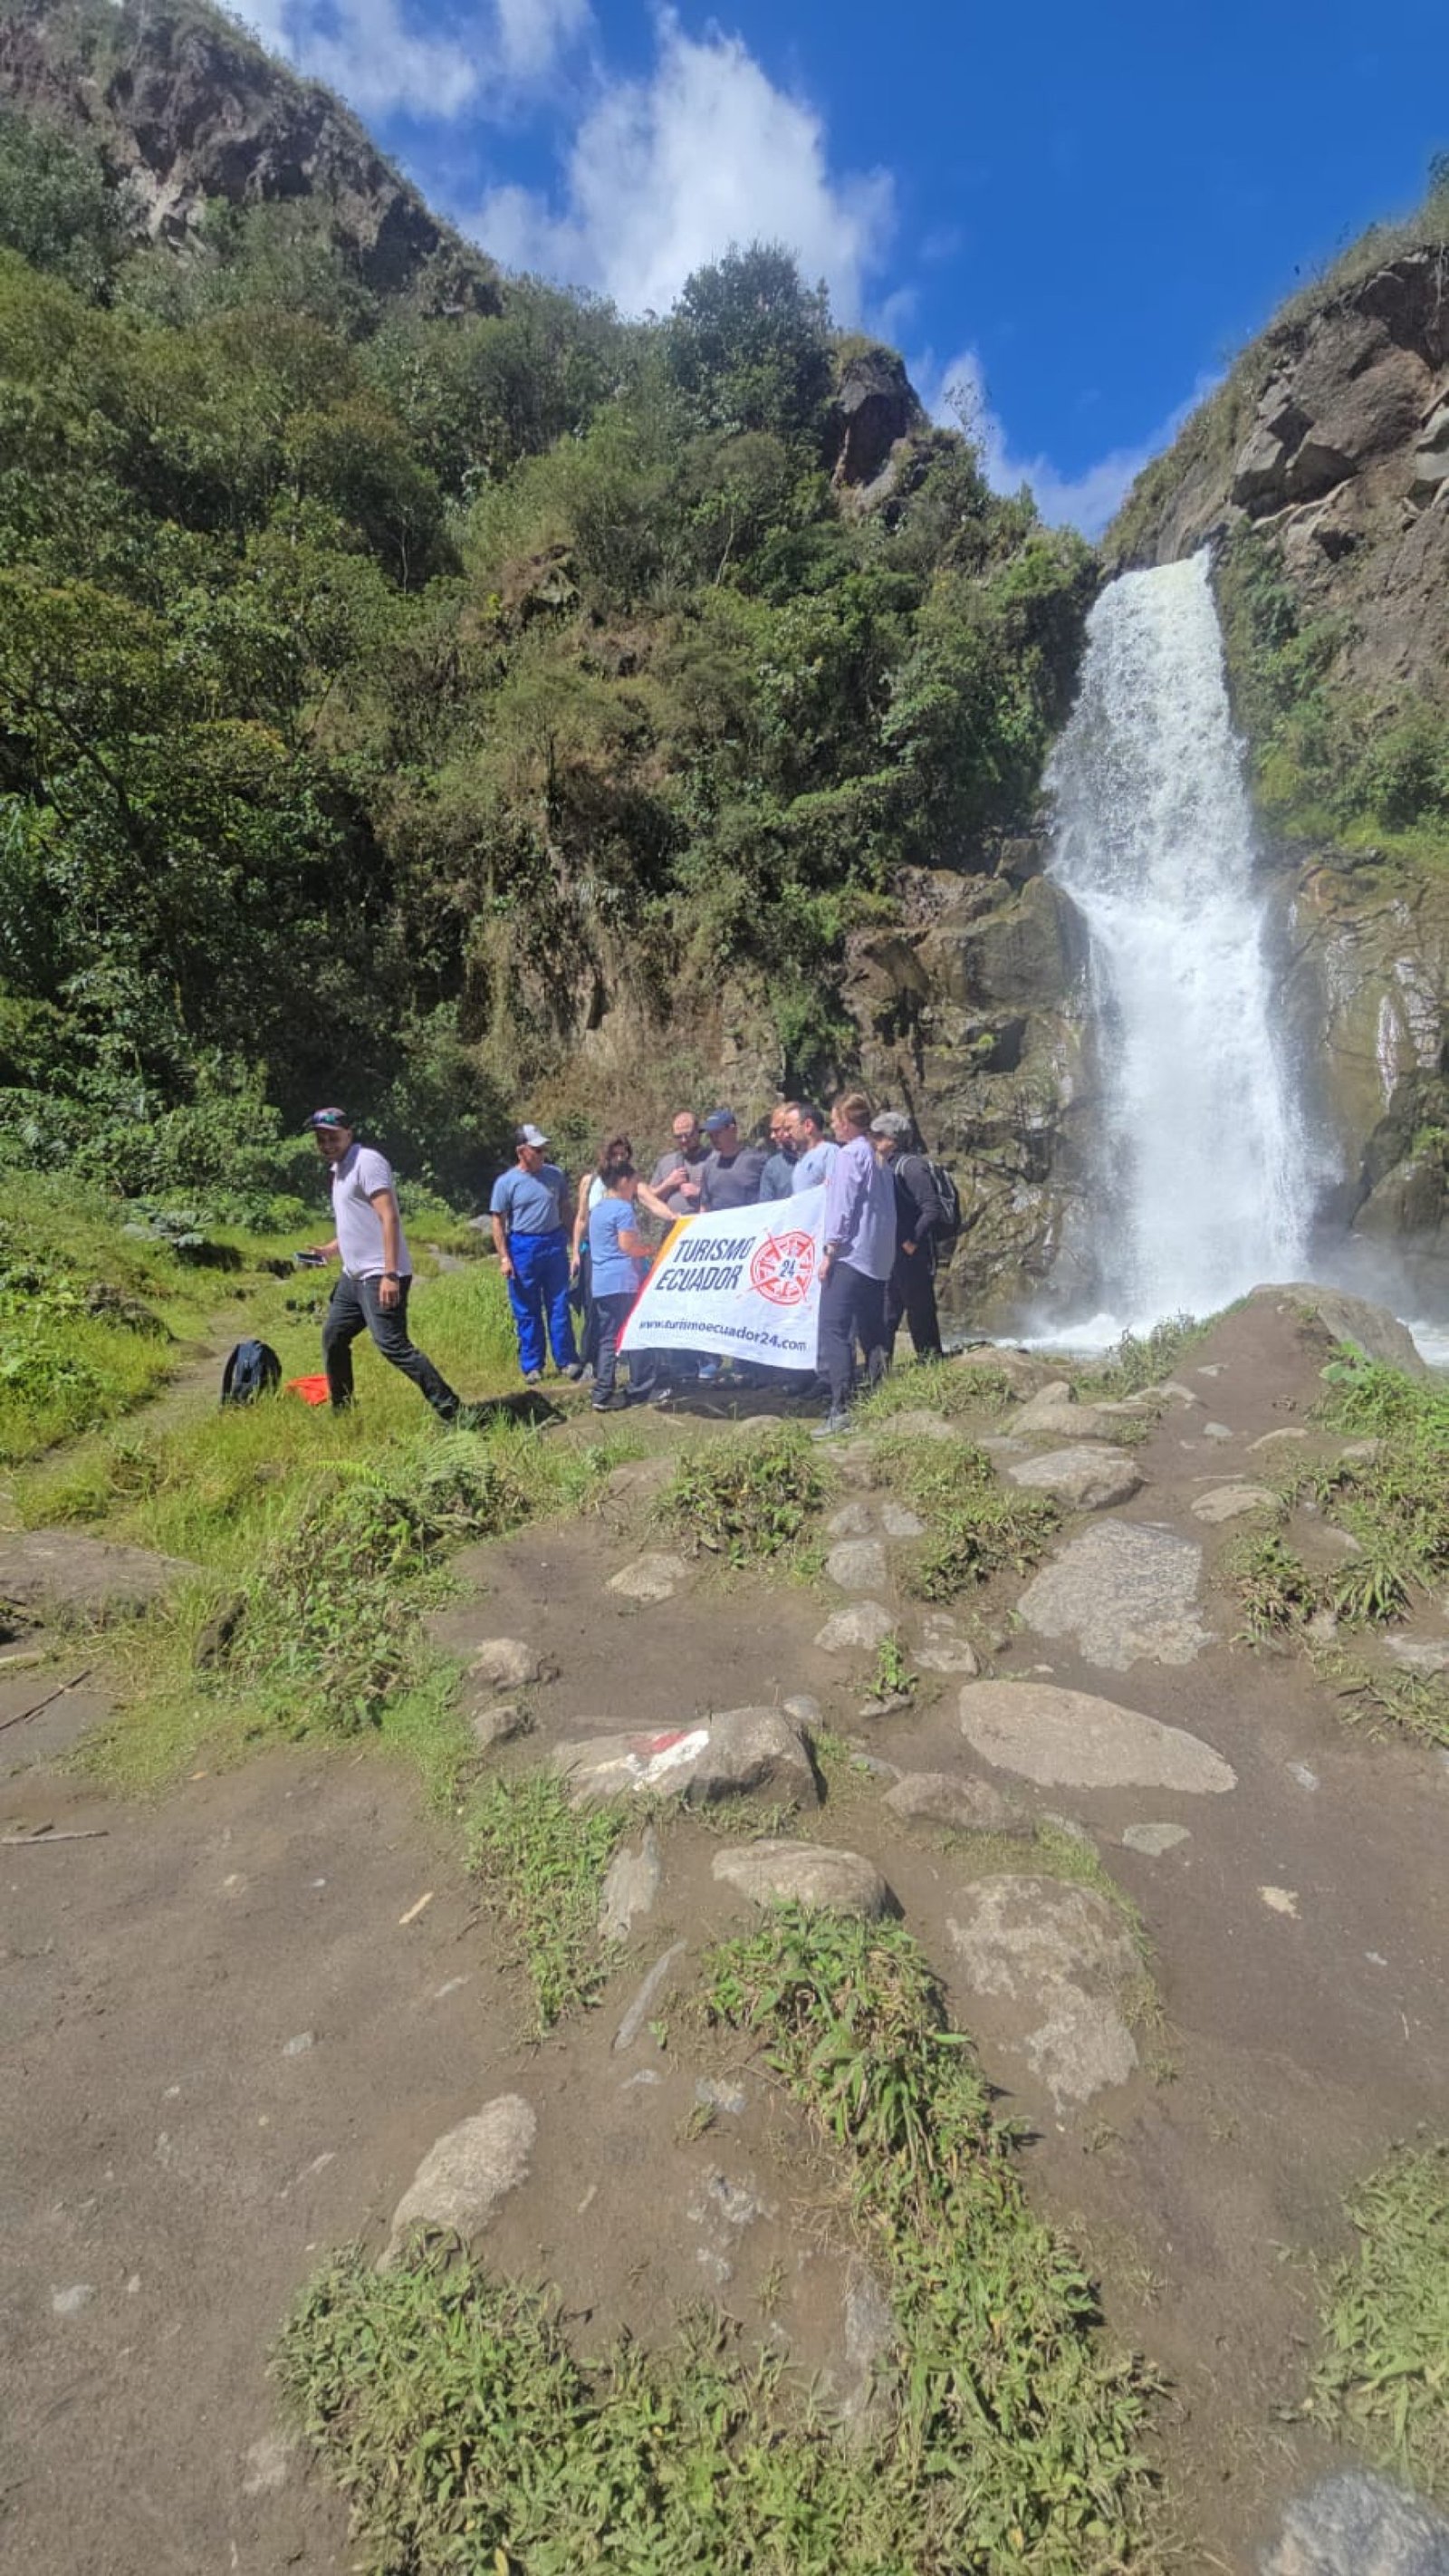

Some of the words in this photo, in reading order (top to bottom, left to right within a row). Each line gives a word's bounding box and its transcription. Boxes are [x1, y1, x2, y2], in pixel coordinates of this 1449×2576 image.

[674, 1236, 756, 1262] TURISMO
[655, 1265, 743, 1291] ECUADOR
[779, 1260, 795, 1278] 24
